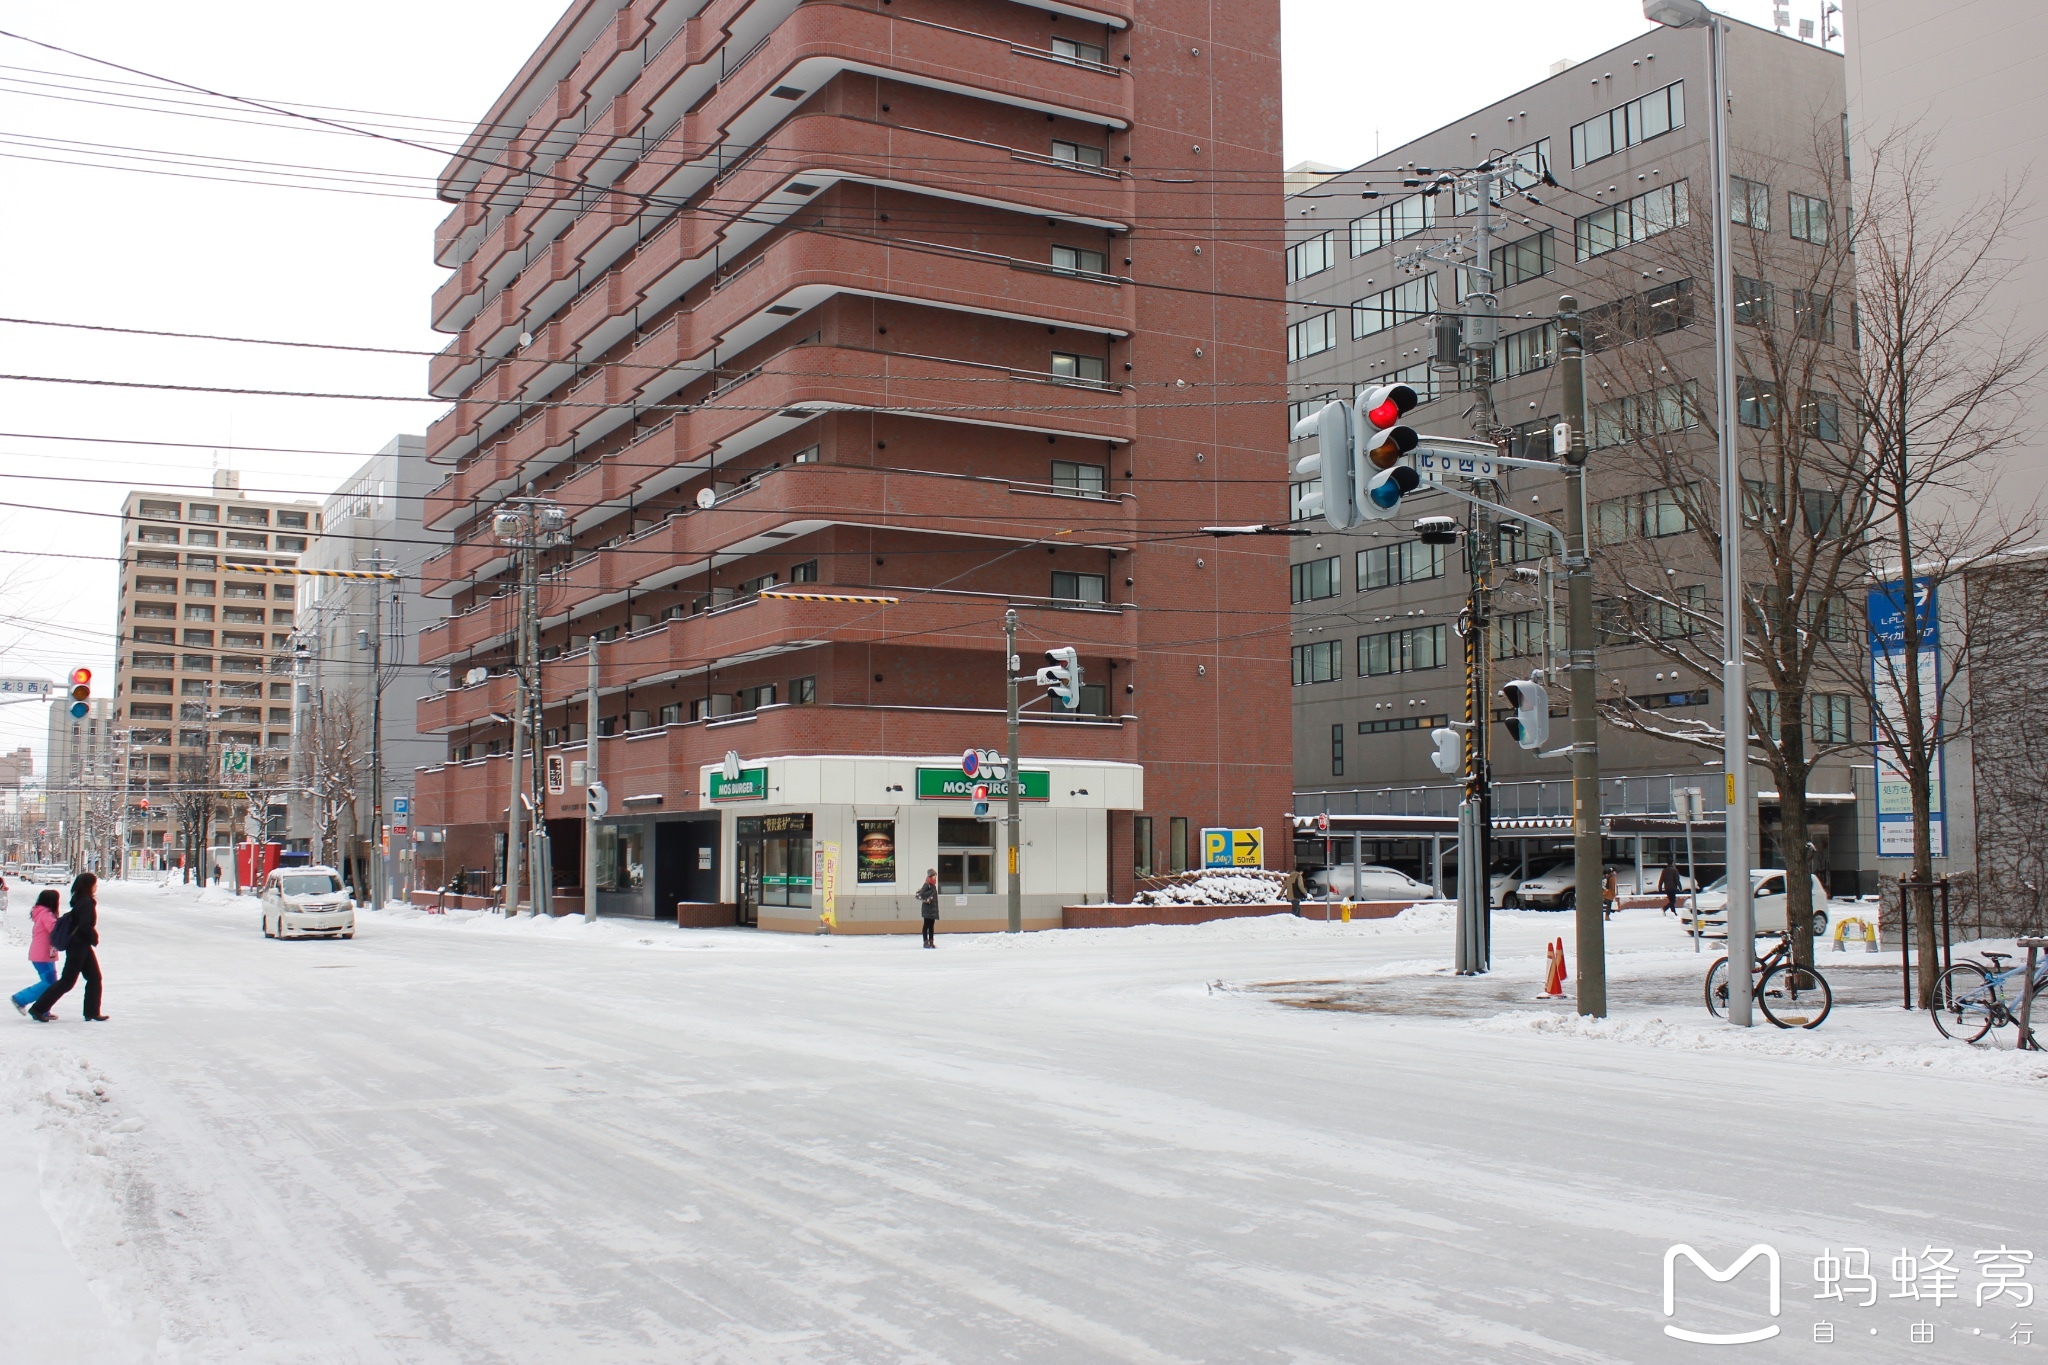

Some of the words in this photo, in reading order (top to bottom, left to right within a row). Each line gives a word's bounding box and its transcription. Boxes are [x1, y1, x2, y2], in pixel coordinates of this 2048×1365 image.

[719, 784, 732, 796] MOS
[732, 782, 753, 795] BURGER
[943, 782, 974, 794] MOS
[395, 801, 406, 811] P
[1206, 833, 1225, 863] P
[1236, 856, 1256, 864] 50m先
